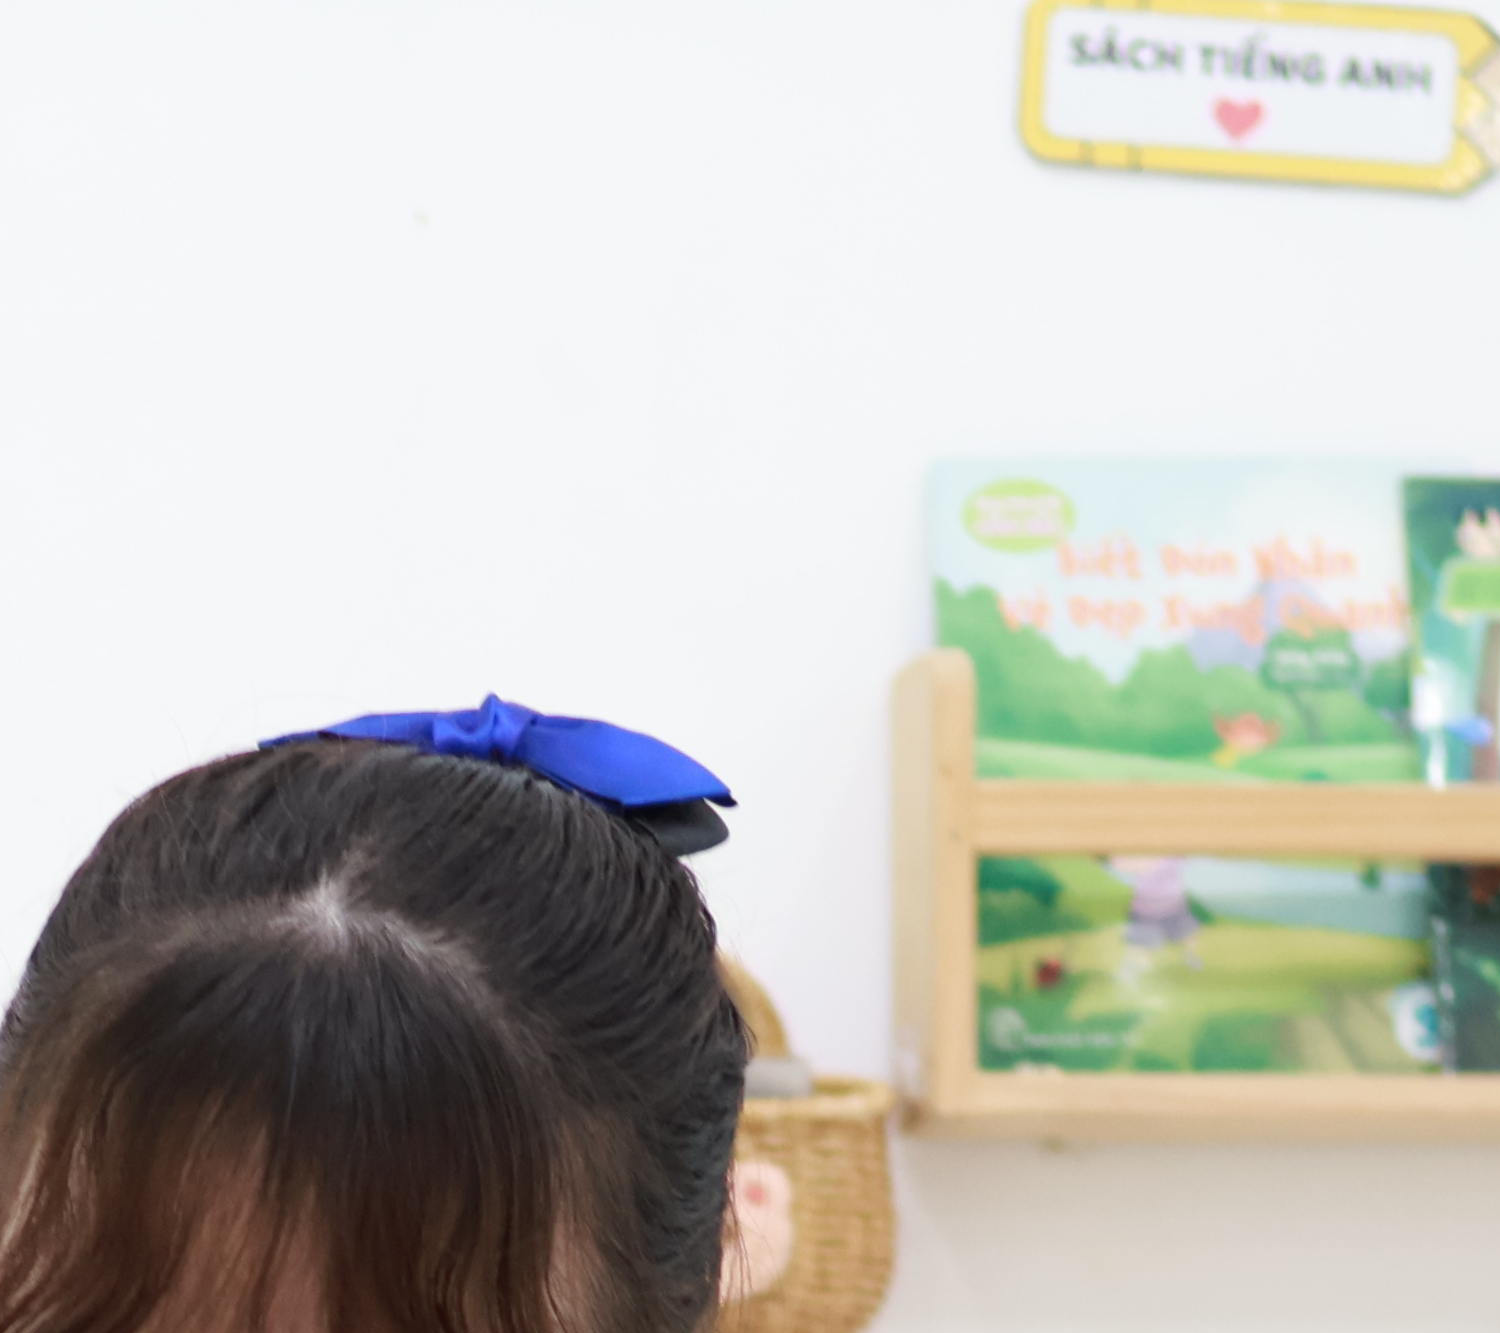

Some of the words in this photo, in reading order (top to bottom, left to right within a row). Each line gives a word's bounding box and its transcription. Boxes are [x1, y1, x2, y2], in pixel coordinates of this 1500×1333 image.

[1068, 27, 1183, 72] SÁCH
[1200, 30, 1326, 88] TIẾNG
[1338, 52, 1433, 93] ANH
